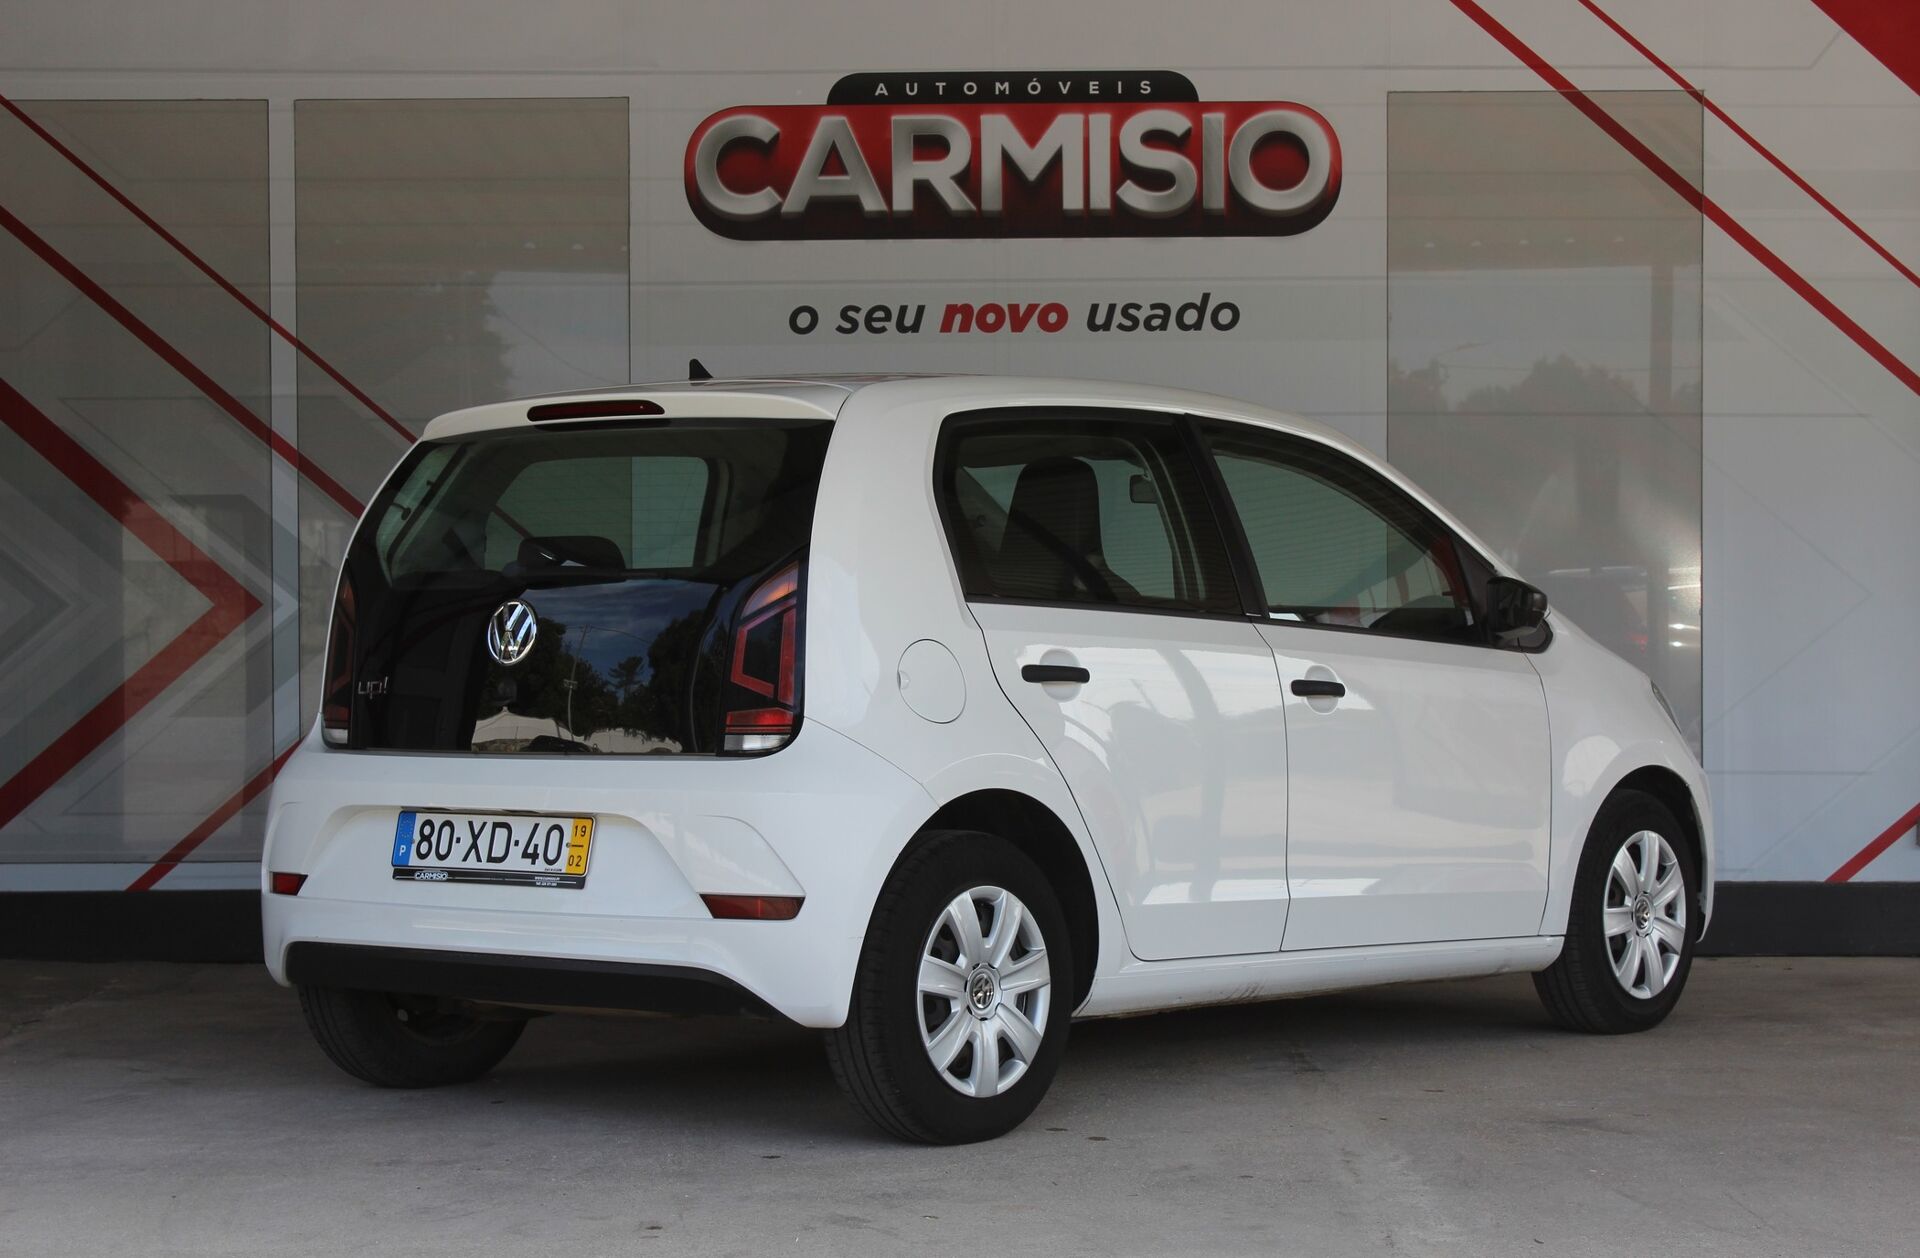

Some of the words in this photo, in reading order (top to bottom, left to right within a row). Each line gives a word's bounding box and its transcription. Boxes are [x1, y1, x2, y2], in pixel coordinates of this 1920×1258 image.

[874, 78, 1152, 97] AUTOMÓVEIS
[695, 110, 1331, 218] CARMISIO
[788, 304, 819, 335] o
[835, 304, 925, 335] seu
[939, 303, 1069, 334] novo
[1086, 292, 1241, 333] usado
[358, 676, 389, 700] up!
[573, 824, 587, 838] 19
[398, 844, 407, 857] P
[567, 855, 582, 868] 02
[415, 871, 448, 881] CARMISIO
